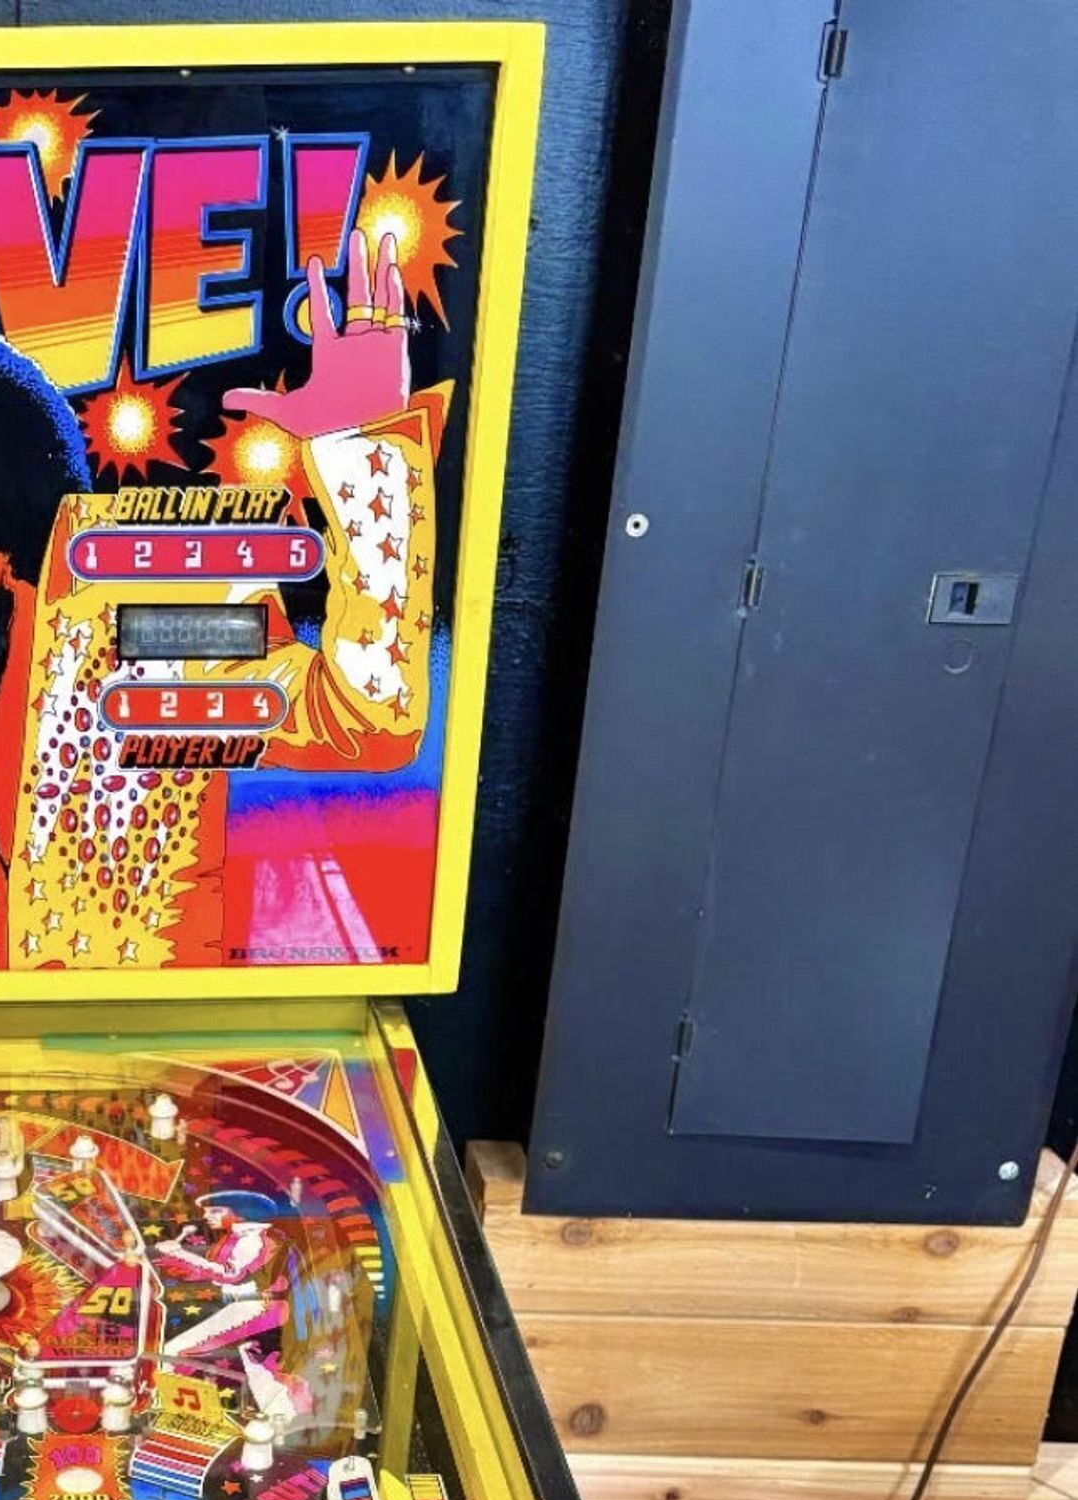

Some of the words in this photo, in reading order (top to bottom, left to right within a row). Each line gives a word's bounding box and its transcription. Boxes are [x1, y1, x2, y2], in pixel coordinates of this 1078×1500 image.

[117, 487, 179, 521] BALL
[180, 487, 209, 521] IN
[213, 487, 285, 521] PLAY
[85, 541, 98, 569] 1
[134, 540, 153, 568] 2
[185, 540, 203, 568] 3
[236, 539, 255, 568] 4
[289, 539, 307, 568] 5
[118, 691, 131, 719] 1
[159, 691, 178, 718] 2
[206, 691, 224, 718] 3
[252, 691, 270, 718] 4
[123, 735, 217, 767] PLAYER
[222, 735, 260, 766] UP
[76, 1286, 133, 1315] 50
